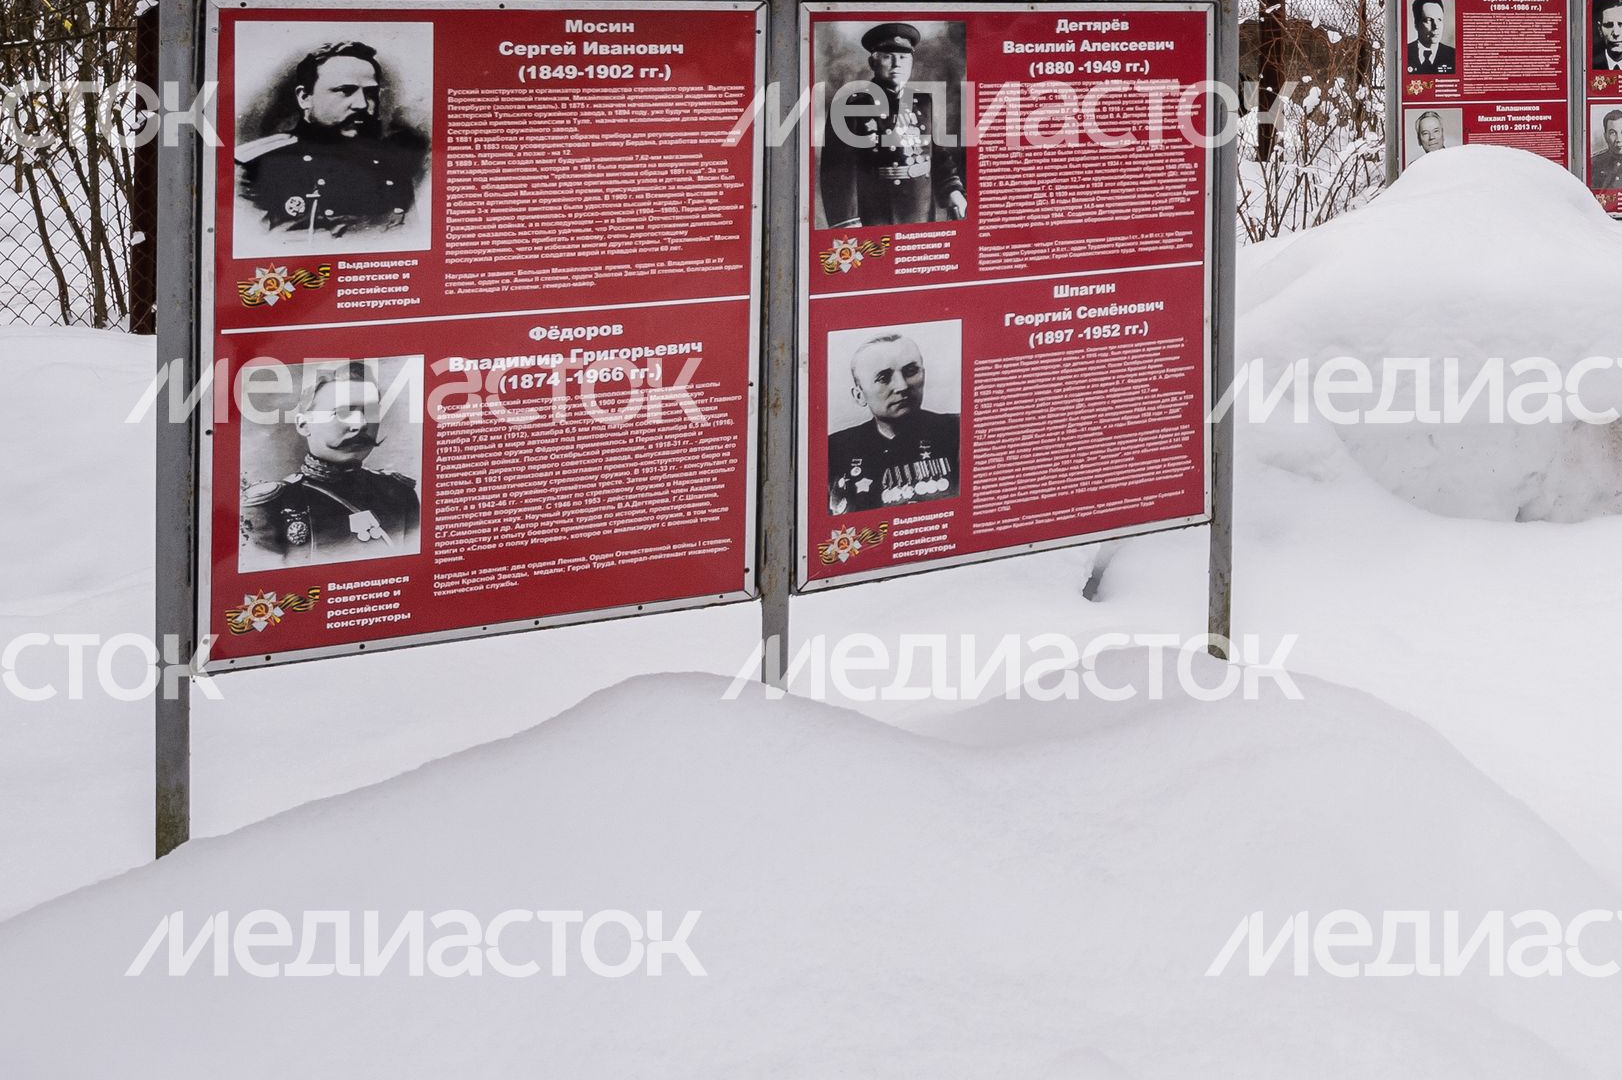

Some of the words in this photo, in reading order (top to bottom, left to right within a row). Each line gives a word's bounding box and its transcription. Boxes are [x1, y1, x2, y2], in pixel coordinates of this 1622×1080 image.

[566, 20, 634, 33] Мосин
[1056, 19, 1129, 33] Дегтярёв
[499, 42, 576, 58] Сергей
[584, 42, 683, 55] Иванович
[1003, 40, 1075, 53] Василий
[1080, 40, 1174, 51] Алексеевич
[519, 65, 633, 82] (1849-1902
[640, 64, 671, 81] гг.)
[1030, 61, 1074, 77] (1880
[1078, 60, 1121, 73] -1949
[1126, 60, 1149, 75] гг.)
[895, 231, 956, 240] Выдающиеся
[895, 243, 942, 251] советские
[338, 260, 418, 270] Выдающиеся
[895, 254, 949, 264] российские
[895, 264, 958, 274] конструкторы
[338, 274, 399, 282] советские
[337, 286, 409, 297] российские
[1054, 284, 1115, 298] Шпагин
[337, 298, 420, 308] конструкторы
[1005, 308, 1072, 326] Георгий
[1077, 301, 1163, 319] Семёнович
[529, 325, 623, 341] Фёдоров
[1029, 329, 1074, 348] (1897
[1078, 324, 1120, 339] -1952
[1125, 321, 1148, 336] гг.)
[448, 353, 563, 373] Владимир
[570, 341, 703, 367] Григорьевич
[498, 373, 560, 394] (1874
[565, 367, 623, 384] -1966
[630, 364, 661, 381] гг.)
[893, 511, 954, 525] Выдающиеся
[505, 540, 528, 548] полку
[570, 530, 601, 541] которое
[614, 524, 660, 534] анализирует
[667, 518, 698, 526] военной
[893, 524, 940, 537] советские
[892, 534, 947, 549] российские
[892, 543, 956, 559] конструкторы
[434, 556, 465, 564] зрения.
[434, 571, 469, 580] Награды
[479, 566, 508, 574] звания:
[527, 560, 555, 570] ордена
[589, 553, 614, 561] Орден
[615, 544, 671, 557] Отечественной
[434, 581, 460, 589] Орден
[462, 575, 495, 586] Красной
[567, 563, 590, 571] Герой
[618, 551, 687, 565] генерал-лейтенант
[327, 575, 409, 591] Выдающиеся
[433, 585, 483, 597] технической
[485, 581, 519, 590] службы.
[327, 590, 390, 605] советские
[394, 589, 401, 597] и
[327, 602, 400, 618] российские
[326, 612, 411, 629] конструкторы
